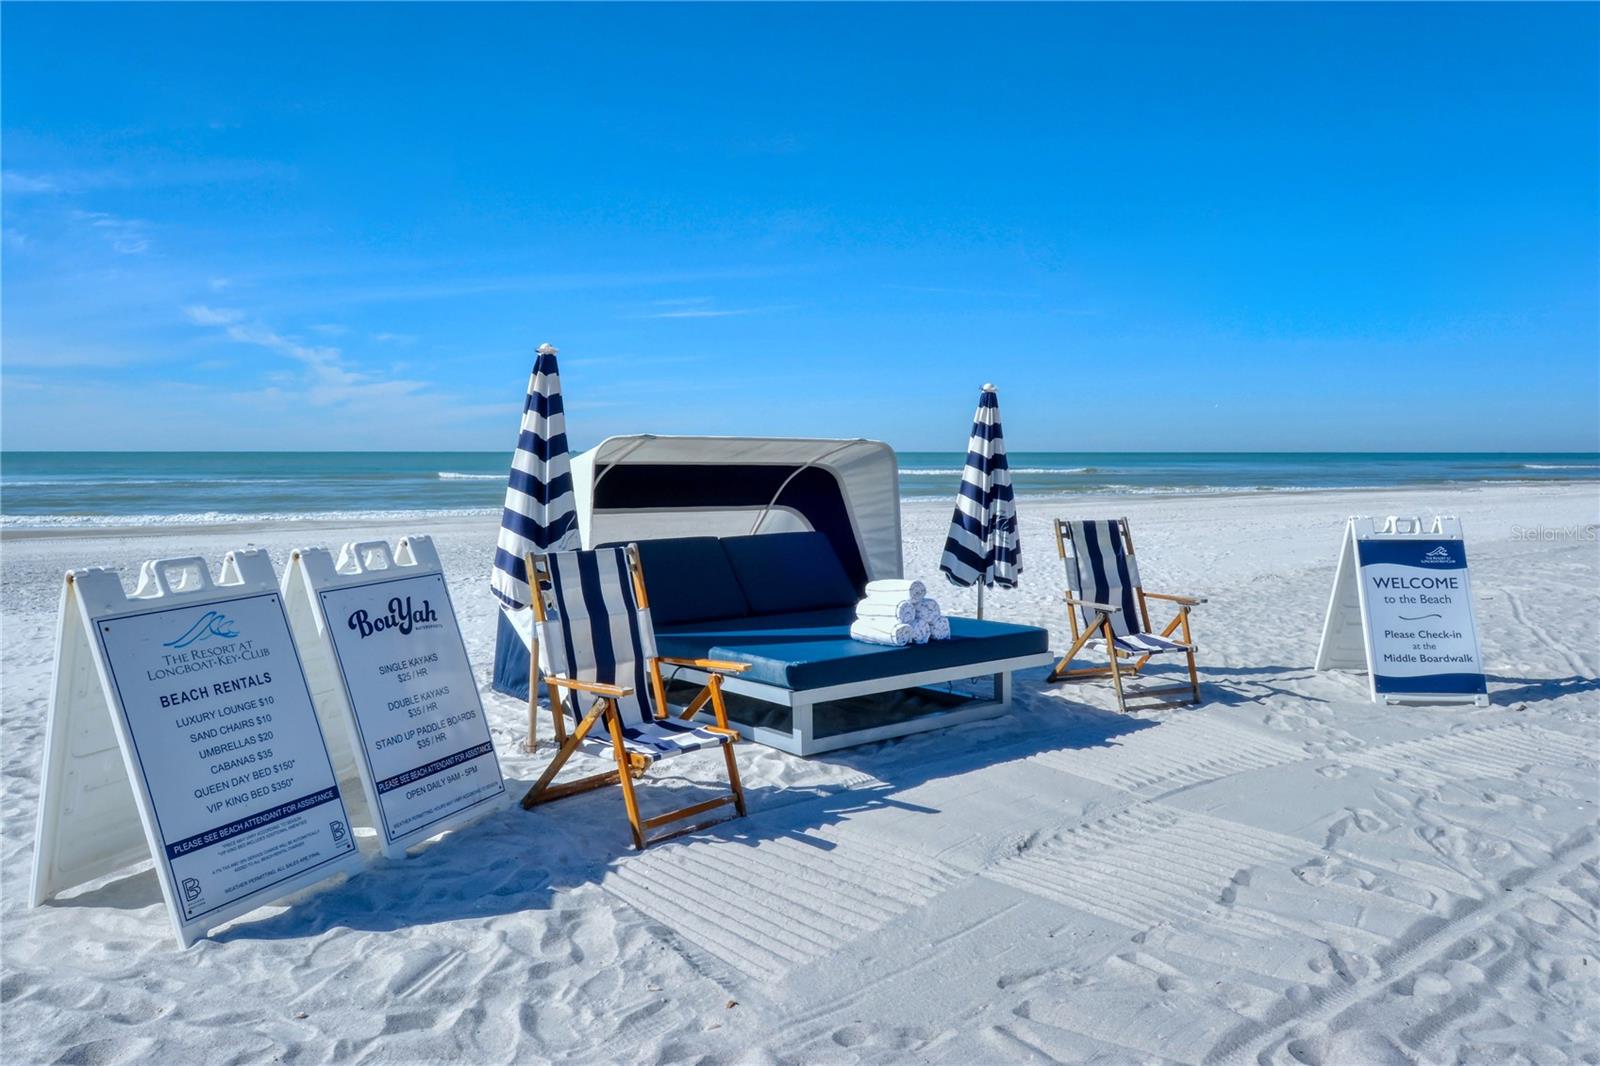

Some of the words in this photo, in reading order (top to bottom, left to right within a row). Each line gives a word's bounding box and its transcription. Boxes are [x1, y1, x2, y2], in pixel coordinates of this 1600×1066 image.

[1372, 577, 1458, 589] WELCOME
[1384, 595, 1396, 604] to
[1399, 594, 1416, 604] the
[1420, 594, 1452, 604] Beach
[348, 596, 438, 639] BouYah
[1384, 630, 1415, 639] Please
[1418, 630, 1462, 639] Check-in
[1422, 642, 1436, 650] the
[162, 654, 189, 666] THE
[191, 644, 235, 660] RESORT
[239, 640, 253, 650] AT
[379, 660, 408, 675] SINGLE
[409, 653, 438, 667] KAYAKS
[1384, 654, 1416, 663] Middle
[1420, 654, 1474, 663] Boardwalk
[398, 672, 412, 683] $25
[416, 668, 428, 677] HR
[160, 686, 209, 708] BEACH
[214, 672, 272, 696] RENTALS
[388, 695, 419, 711] DOUBLE
[420, 686, 450, 701] KAYAKS
[176, 710, 216, 728] LUXURY
[218, 700, 258, 717] LOUNGE
[259, 696, 274, 707] $10
[408, 708, 422, 718] $35
[426, 702, 438, 712] HR
[190, 729, 218, 743] SAND
[220, 718, 255, 735] CHAIRS
[256, 714, 272, 725] $10
[376, 734, 404, 750] STAND
[405, 730, 416, 740] UP
[416, 720, 446, 736] PADDLE
[447, 710, 476, 726] BOARDS
[434, 732, 447, 743] HR
[199, 736, 256, 759] UMBRELLAS
[258, 731, 274, 742] $20
[210, 754, 256, 775] CABANAS
[257, 749, 274, 761] $35
[378, 777, 400, 791] PLEASE
[400, 772, 410, 783] SEE
[410, 766, 426, 780] BEACH
[426, 757, 454, 774] ATTENDANT
[455, 752, 465, 762] FOR
[464, 743, 492, 758] ASSISTANCE
[194, 782, 230, 799] QUEEN
[231, 774, 251, 788] DAY
[252, 767, 272, 780] BED
[406, 786, 426, 800] OPEN
[427, 779, 446, 792] DAILY
[446, 773, 461, 784] 9AM
[464, 765, 478, 777] 5PM
[206, 801, 223, 814] VIP
[225, 792, 250, 808] KING
[251, 785, 270, 799] BED
[173, 834, 203, 854] PLEASE
[204, 828, 219, 842] SEE
[219, 820, 244, 837] BEACH
[244, 808, 283, 829] ATTENDANT
[283, 803, 297, 815] FOR
[298, 790, 334, 808] ASSISTANCE
